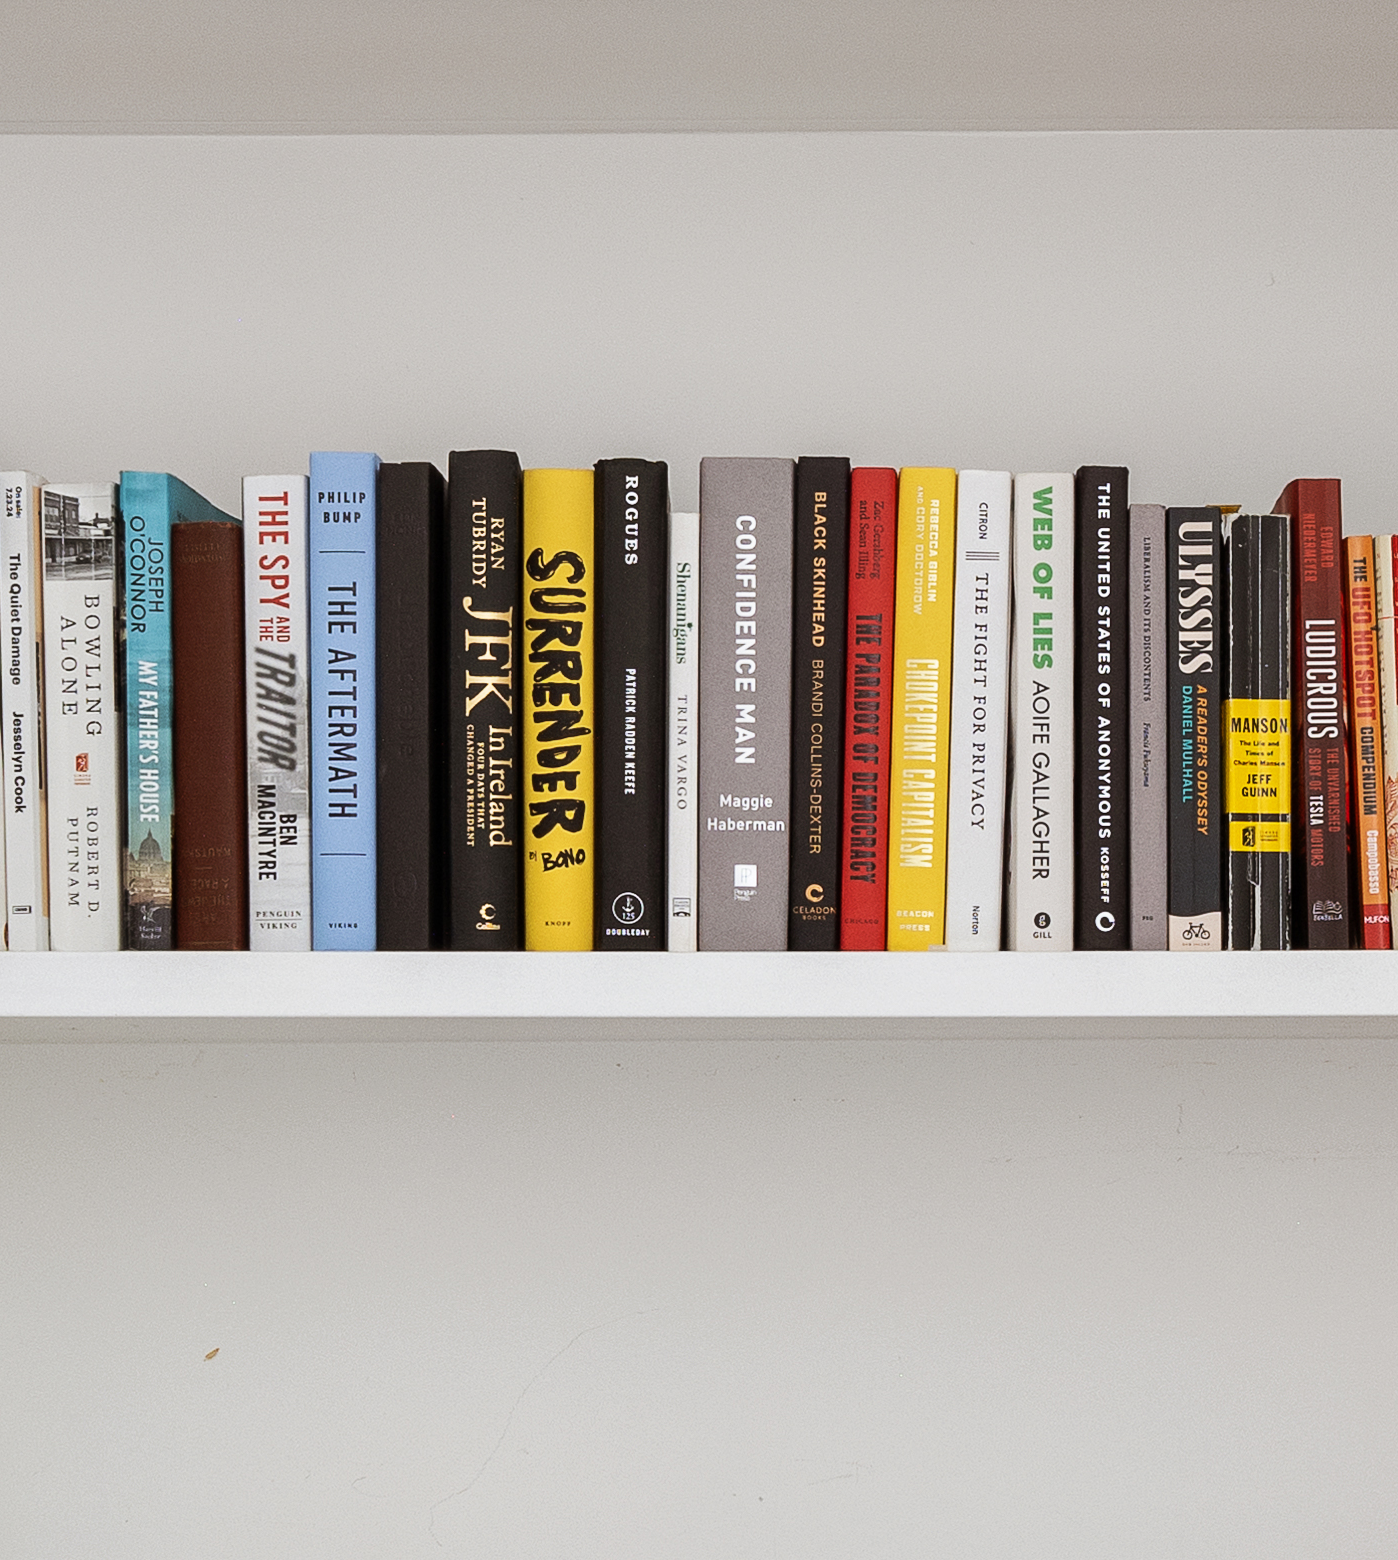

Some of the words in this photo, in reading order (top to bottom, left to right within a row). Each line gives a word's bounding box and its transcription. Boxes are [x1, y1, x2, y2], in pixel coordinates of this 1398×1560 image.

[258, 492, 289, 545] THE
[624, 475, 638, 565] ROGUES
[813, 492, 827, 550] BLACK
[1032, 486, 1052, 551] WEB
[1097, 483, 1110, 521] THE
[472, 498, 486, 588] TUBRIDY
[490, 517, 504, 569] RYAN
[1097, 528, 1111, 598] UNITED
[260, 555, 290, 609] SPY
[328, 582, 357, 635] THE
[673, 563, 692, 664] Shenanigans
[735, 516, 756, 692] CONFIDENCE
[811, 557, 825, 647] SKINHEAD
[1032, 562, 1052, 600] OF
[1178, 521, 1213, 674] ULYSSES
[259, 618, 273, 641] THE
[276, 616, 290, 643] AND
[462, 597, 512, 716] JFK
[1033, 612, 1052, 669] LIES
[1097, 606, 1111, 674] STATES
[60, 616, 78, 716] ALONE
[84, 595, 101, 736] BOWLING
[138, 661, 156, 686] MY
[526, 548, 591, 839] SURRENDER
[1097, 682, 1111, 709] OF
[1305, 619, 1338, 738] LUDICROUS
[254, 648, 297, 773] TRAITOR
[328, 649, 358, 818] AFTERMATH
[677, 695, 687, 746] TRINA
[735, 704, 756, 763] MAN
[901, 659, 939, 761] CHOKEPOINT
[1182, 685, 1193, 735] DANIEL
[140, 770, 159, 822] HOUSE
[677, 755, 687, 810] VARGO
[1097, 716, 1111, 839] ANONYMOUS
[1182, 740, 1193, 803] MULHALL
[900, 768, 936, 868] CAPITALISM
